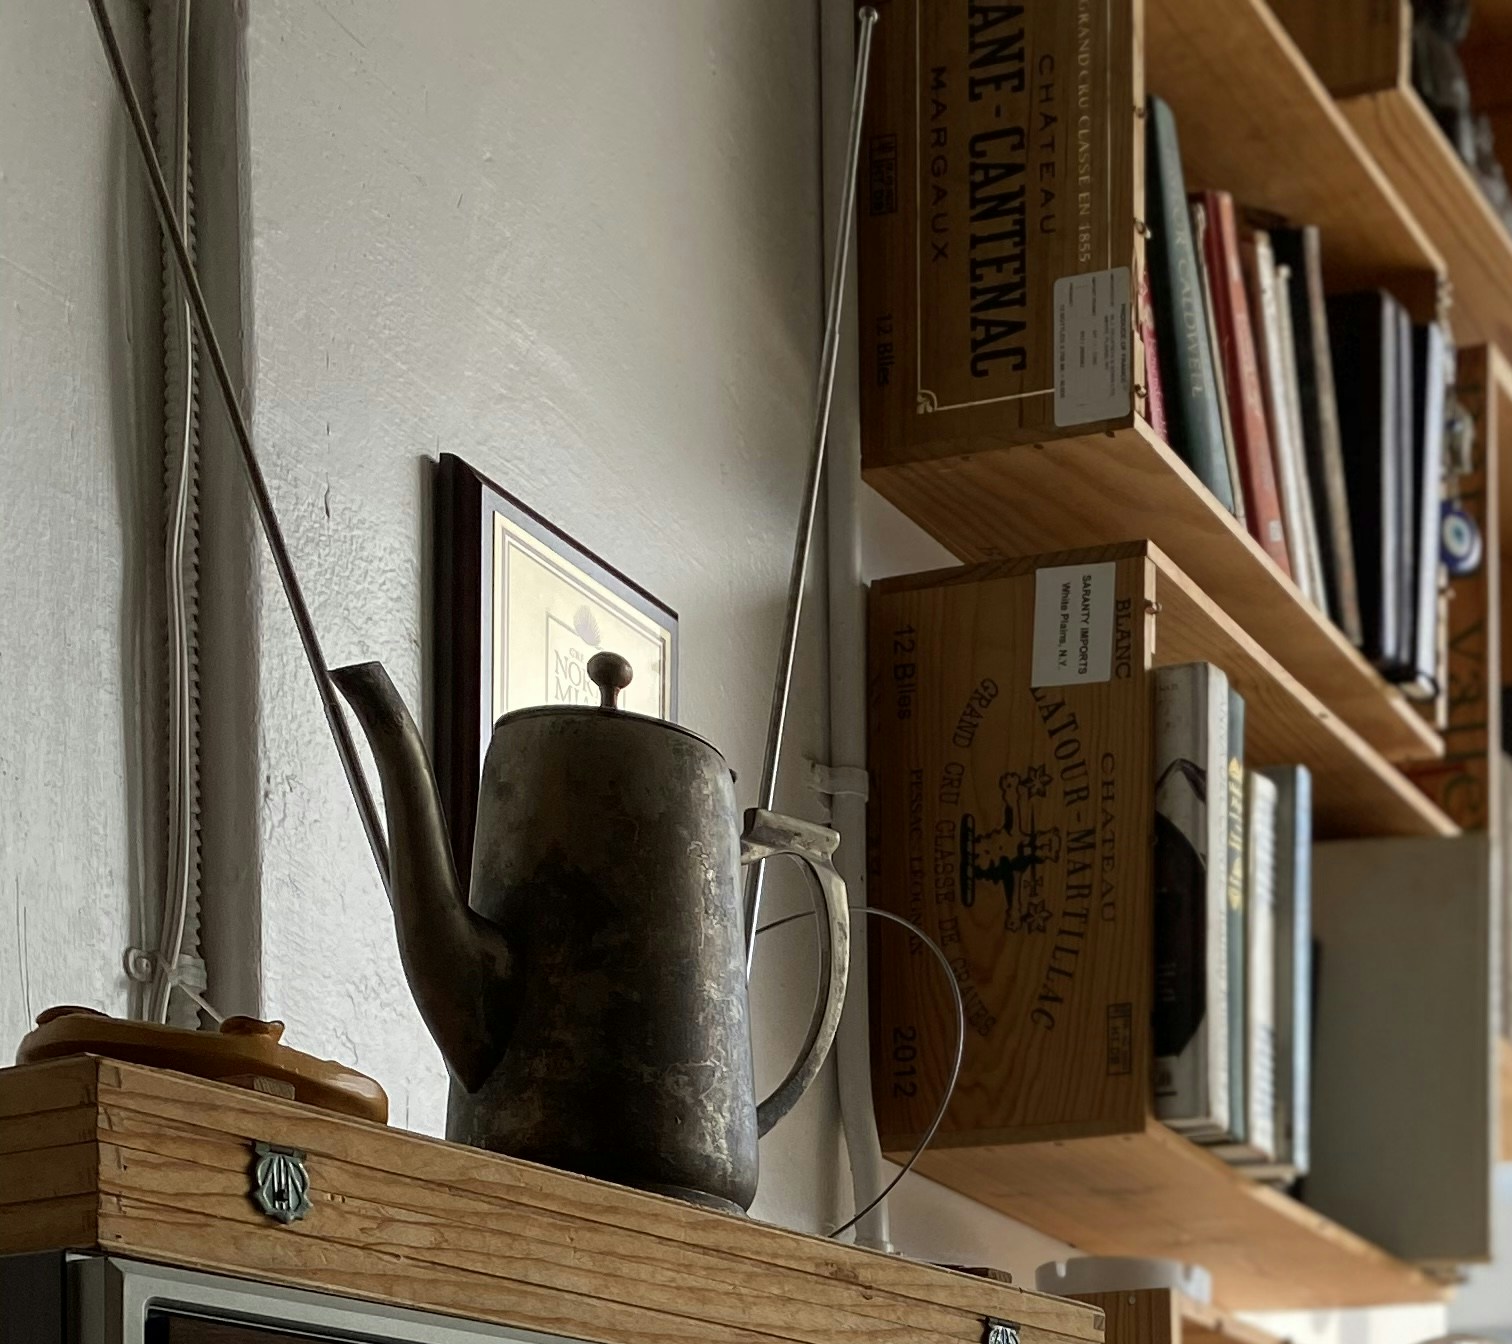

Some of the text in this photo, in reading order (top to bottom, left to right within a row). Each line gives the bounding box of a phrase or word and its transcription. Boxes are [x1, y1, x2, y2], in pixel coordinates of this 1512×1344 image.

[1078, 70, 1091, 108] CRU
[931, 66, 949, 262] MARGAUX
[1079, 191, 1091, 215] EN
[1078, 223, 1091, 263] 1855
[1178, 258, 1204, 398] CALDWELL
[1060, 582, 1071, 611] White
[894, 625, 916, 654] 12
[1078, 575, 1092, 675] SARANTY IMPORTS
[1115, 598, 1132, 680] BLANC
[952, 677, 999, 749] GRAND
[939, 761, 965, 807] CRU
[938, 916, 960, 948] DE
[893, 1025, 917, 1099] 2012
